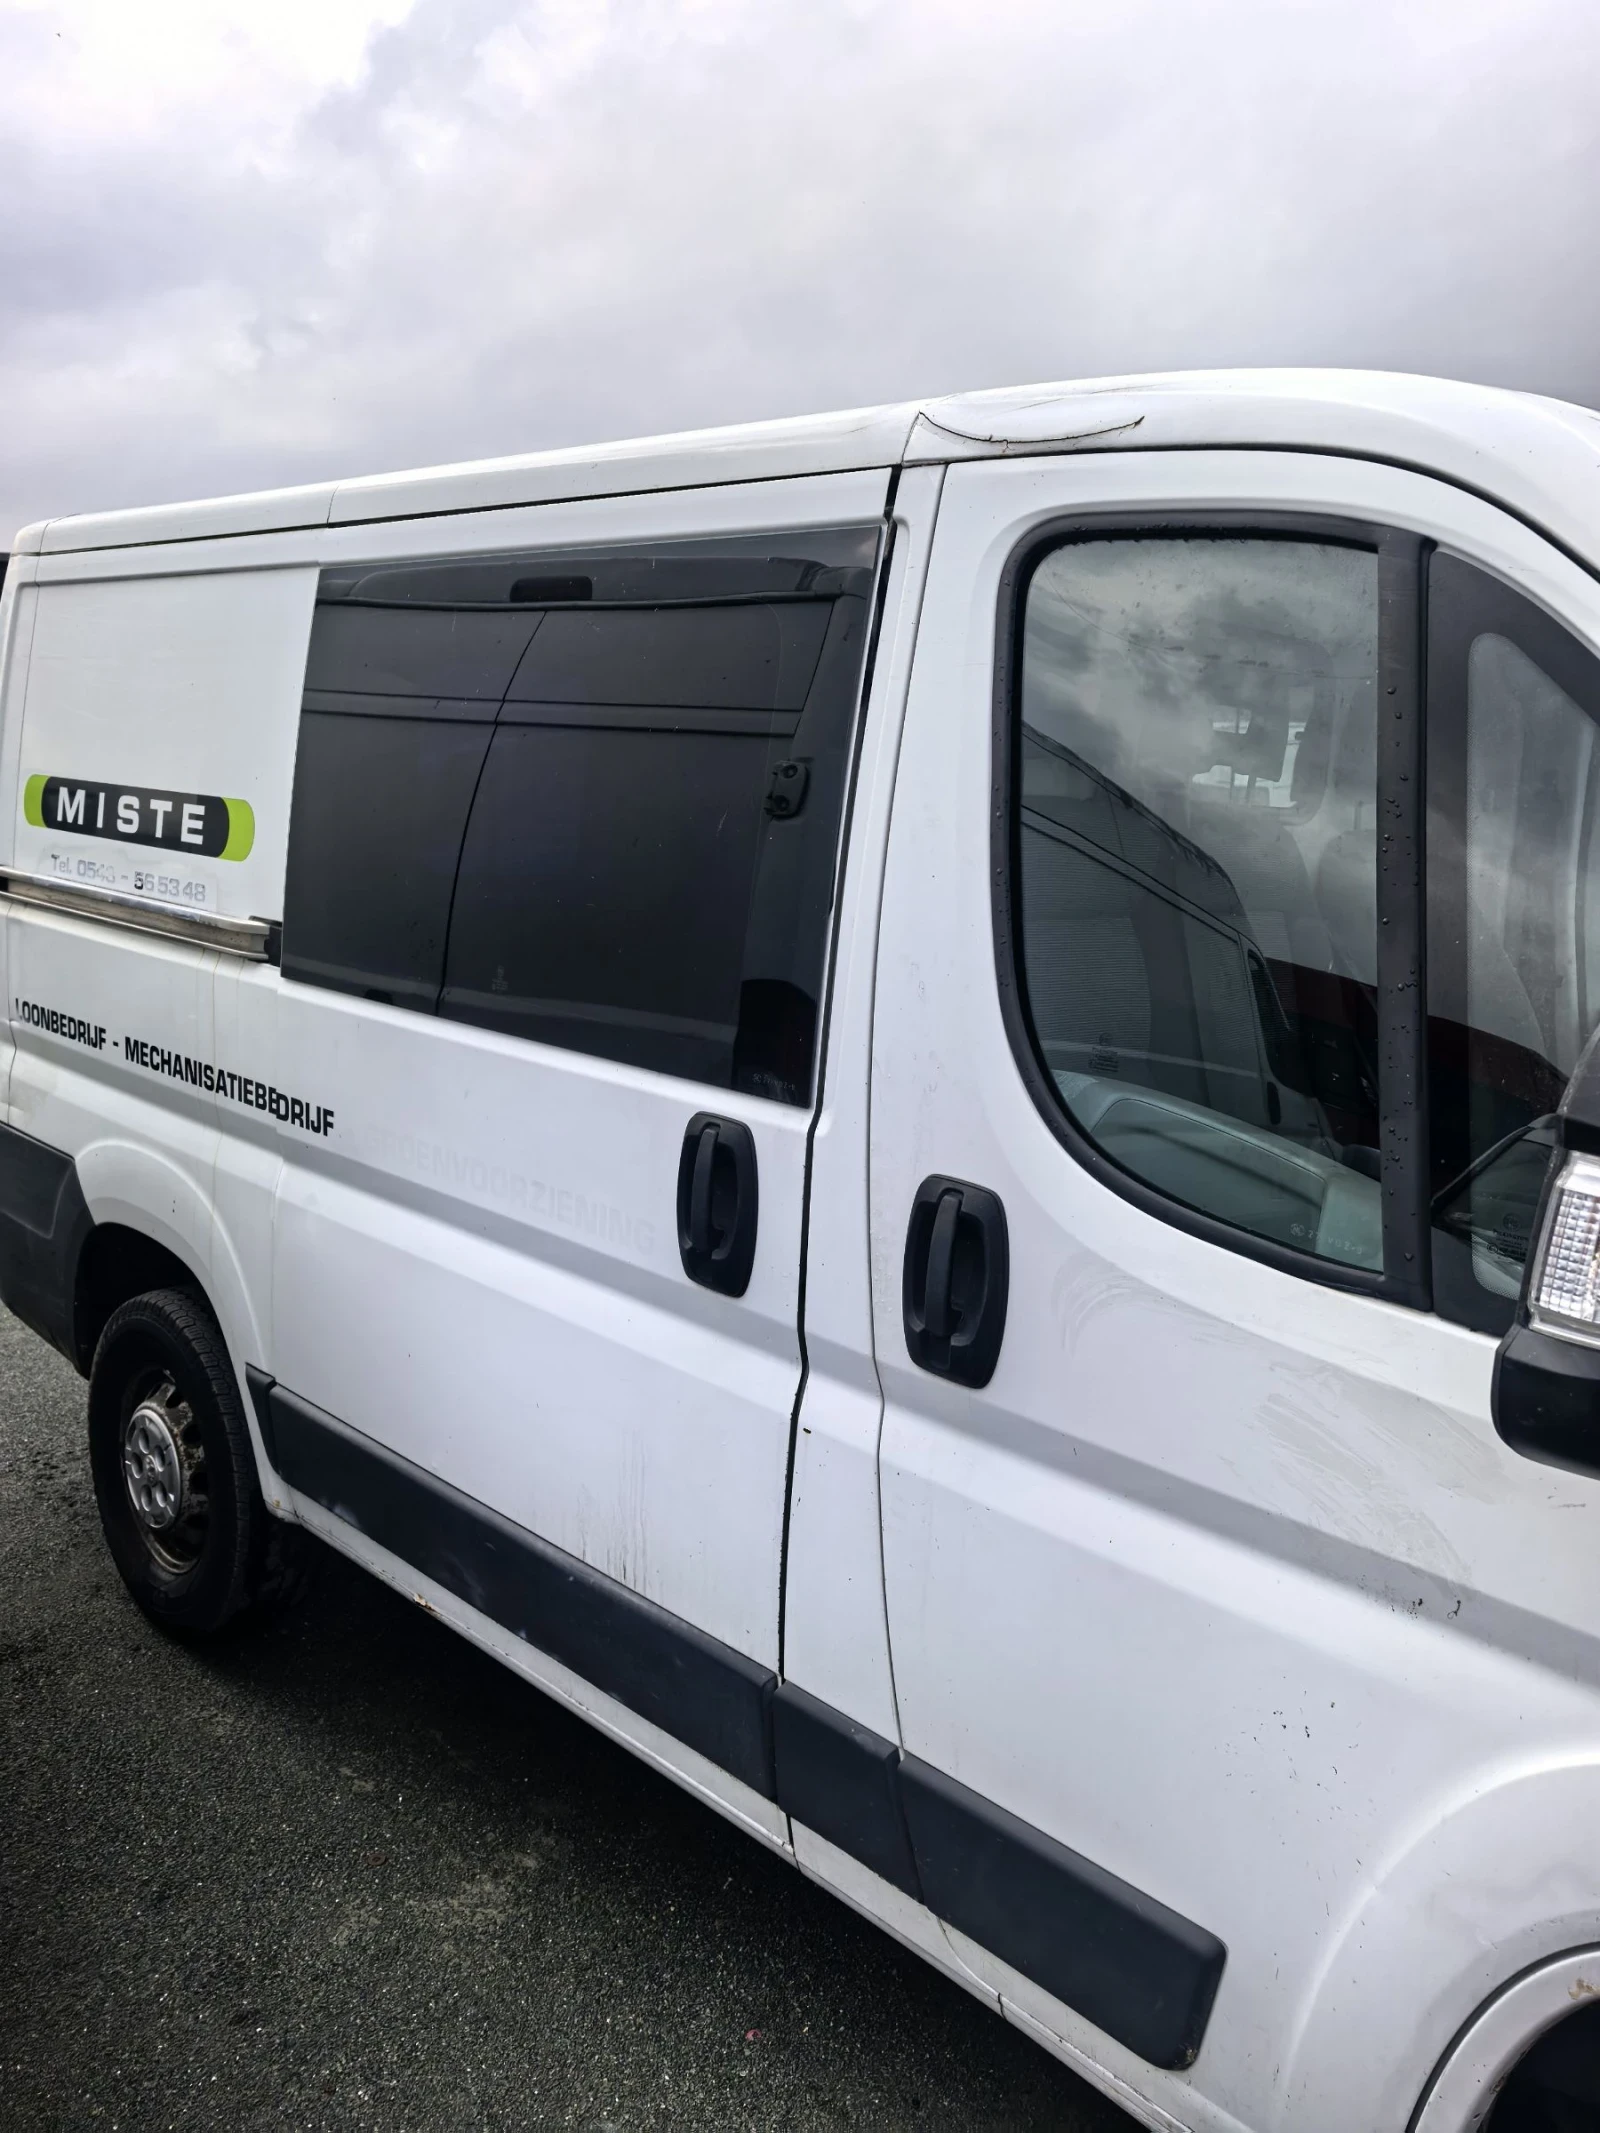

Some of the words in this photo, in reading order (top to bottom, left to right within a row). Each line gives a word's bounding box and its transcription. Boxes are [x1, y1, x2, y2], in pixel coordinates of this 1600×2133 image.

[56, 786, 206, 845] MISTE
[51, 853, 72, 874] Tel.
[15, 997, 106, 1050] LOONBEDRIJF
[125, 1035, 334, 1137] MECHANISATIEBEDRIJF
